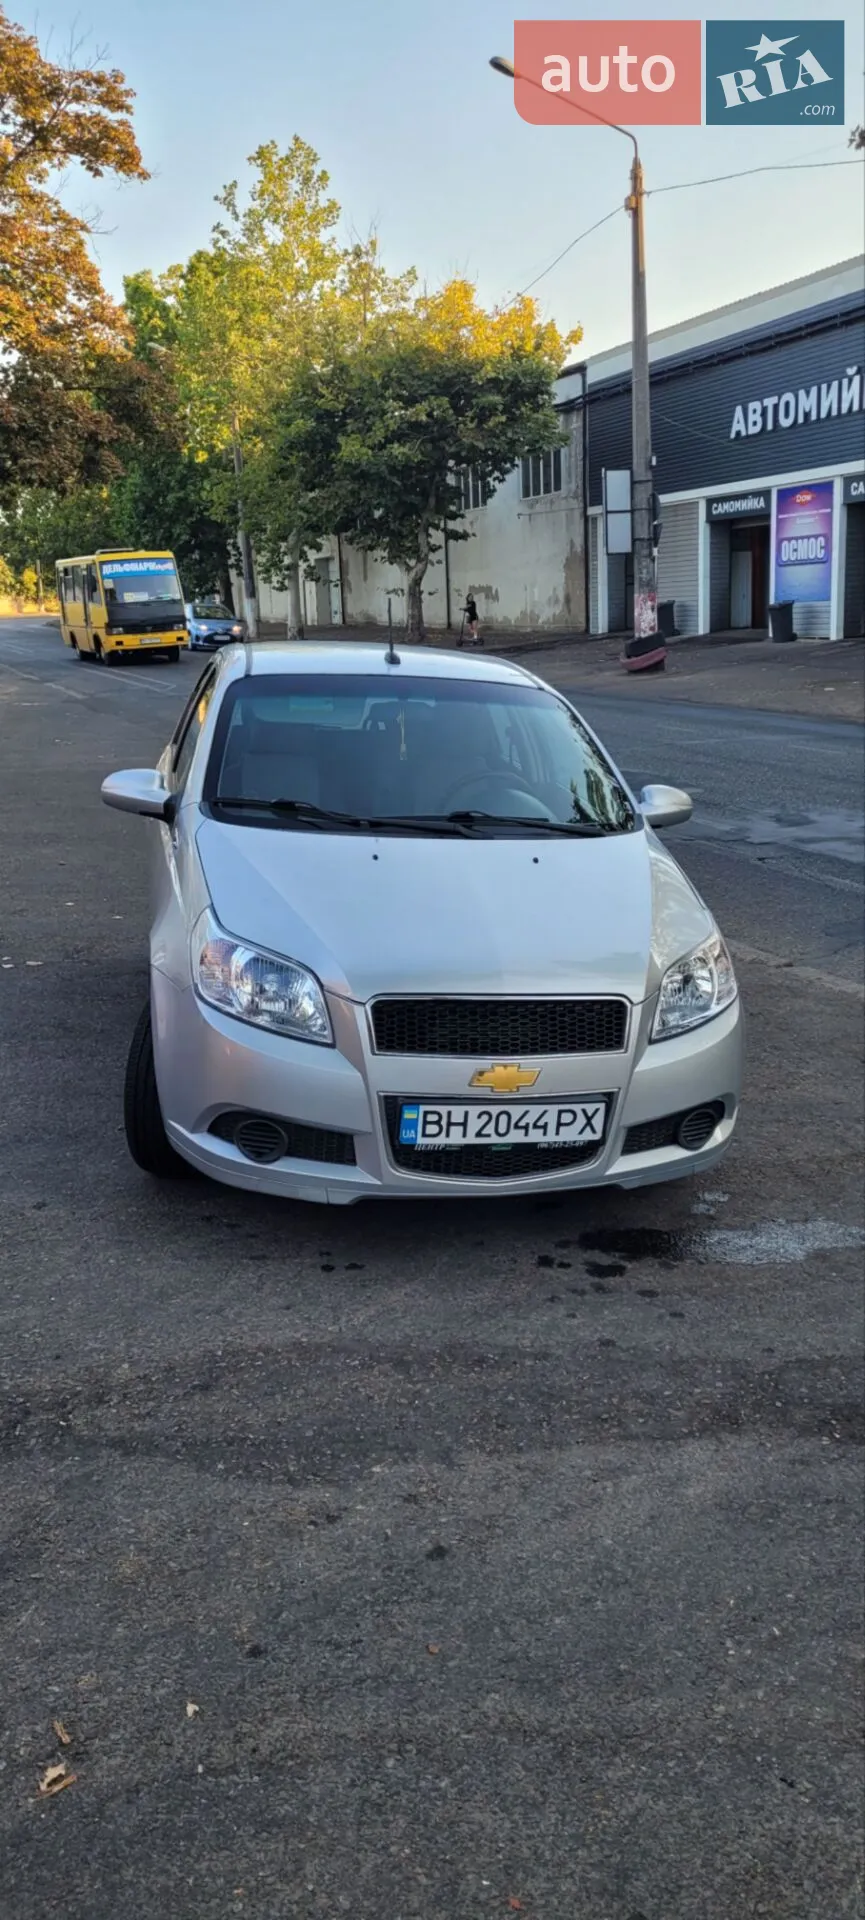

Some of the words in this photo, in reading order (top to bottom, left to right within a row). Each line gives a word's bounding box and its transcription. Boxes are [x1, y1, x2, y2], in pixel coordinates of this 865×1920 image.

[729, 365, 865, 439] АВТОМИЙ
[711, 496, 765, 515] САМОМИЙКА
[781, 535, 826, 562] ОСМОС
[402, 1129, 416, 1138] UA
[420, 1109, 470, 1138] BH
[474, 1109, 550, 1139] 2044
[554, 1107, 601, 1136] PX
